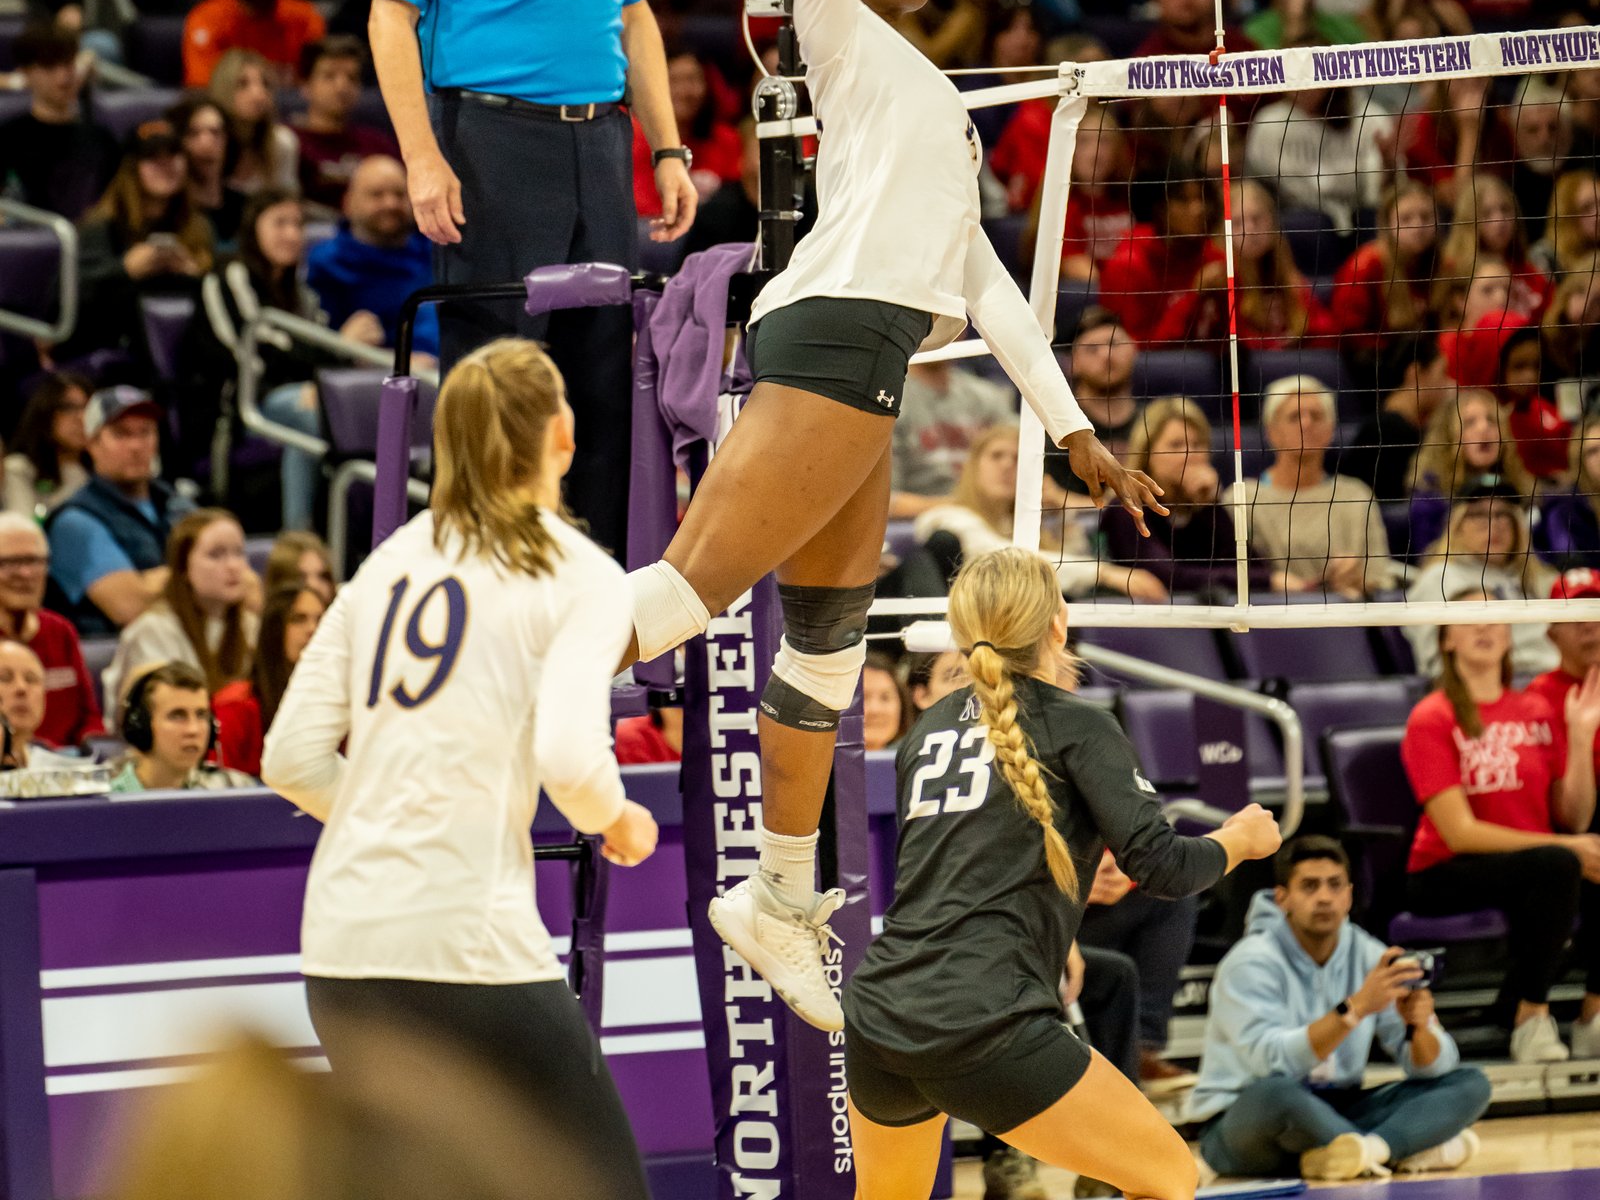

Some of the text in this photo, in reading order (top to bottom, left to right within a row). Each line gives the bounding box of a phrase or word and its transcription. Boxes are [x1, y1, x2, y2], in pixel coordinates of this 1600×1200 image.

[1312, 41, 1472, 81] NORTHWESTERN
[1500, 31, 1600, 66] NORTHWE
[1128, 56, 1285, 89] NORTHWESTERN
[366, 574, 467, 709] 19
[905, 725, 996, 820] 23
